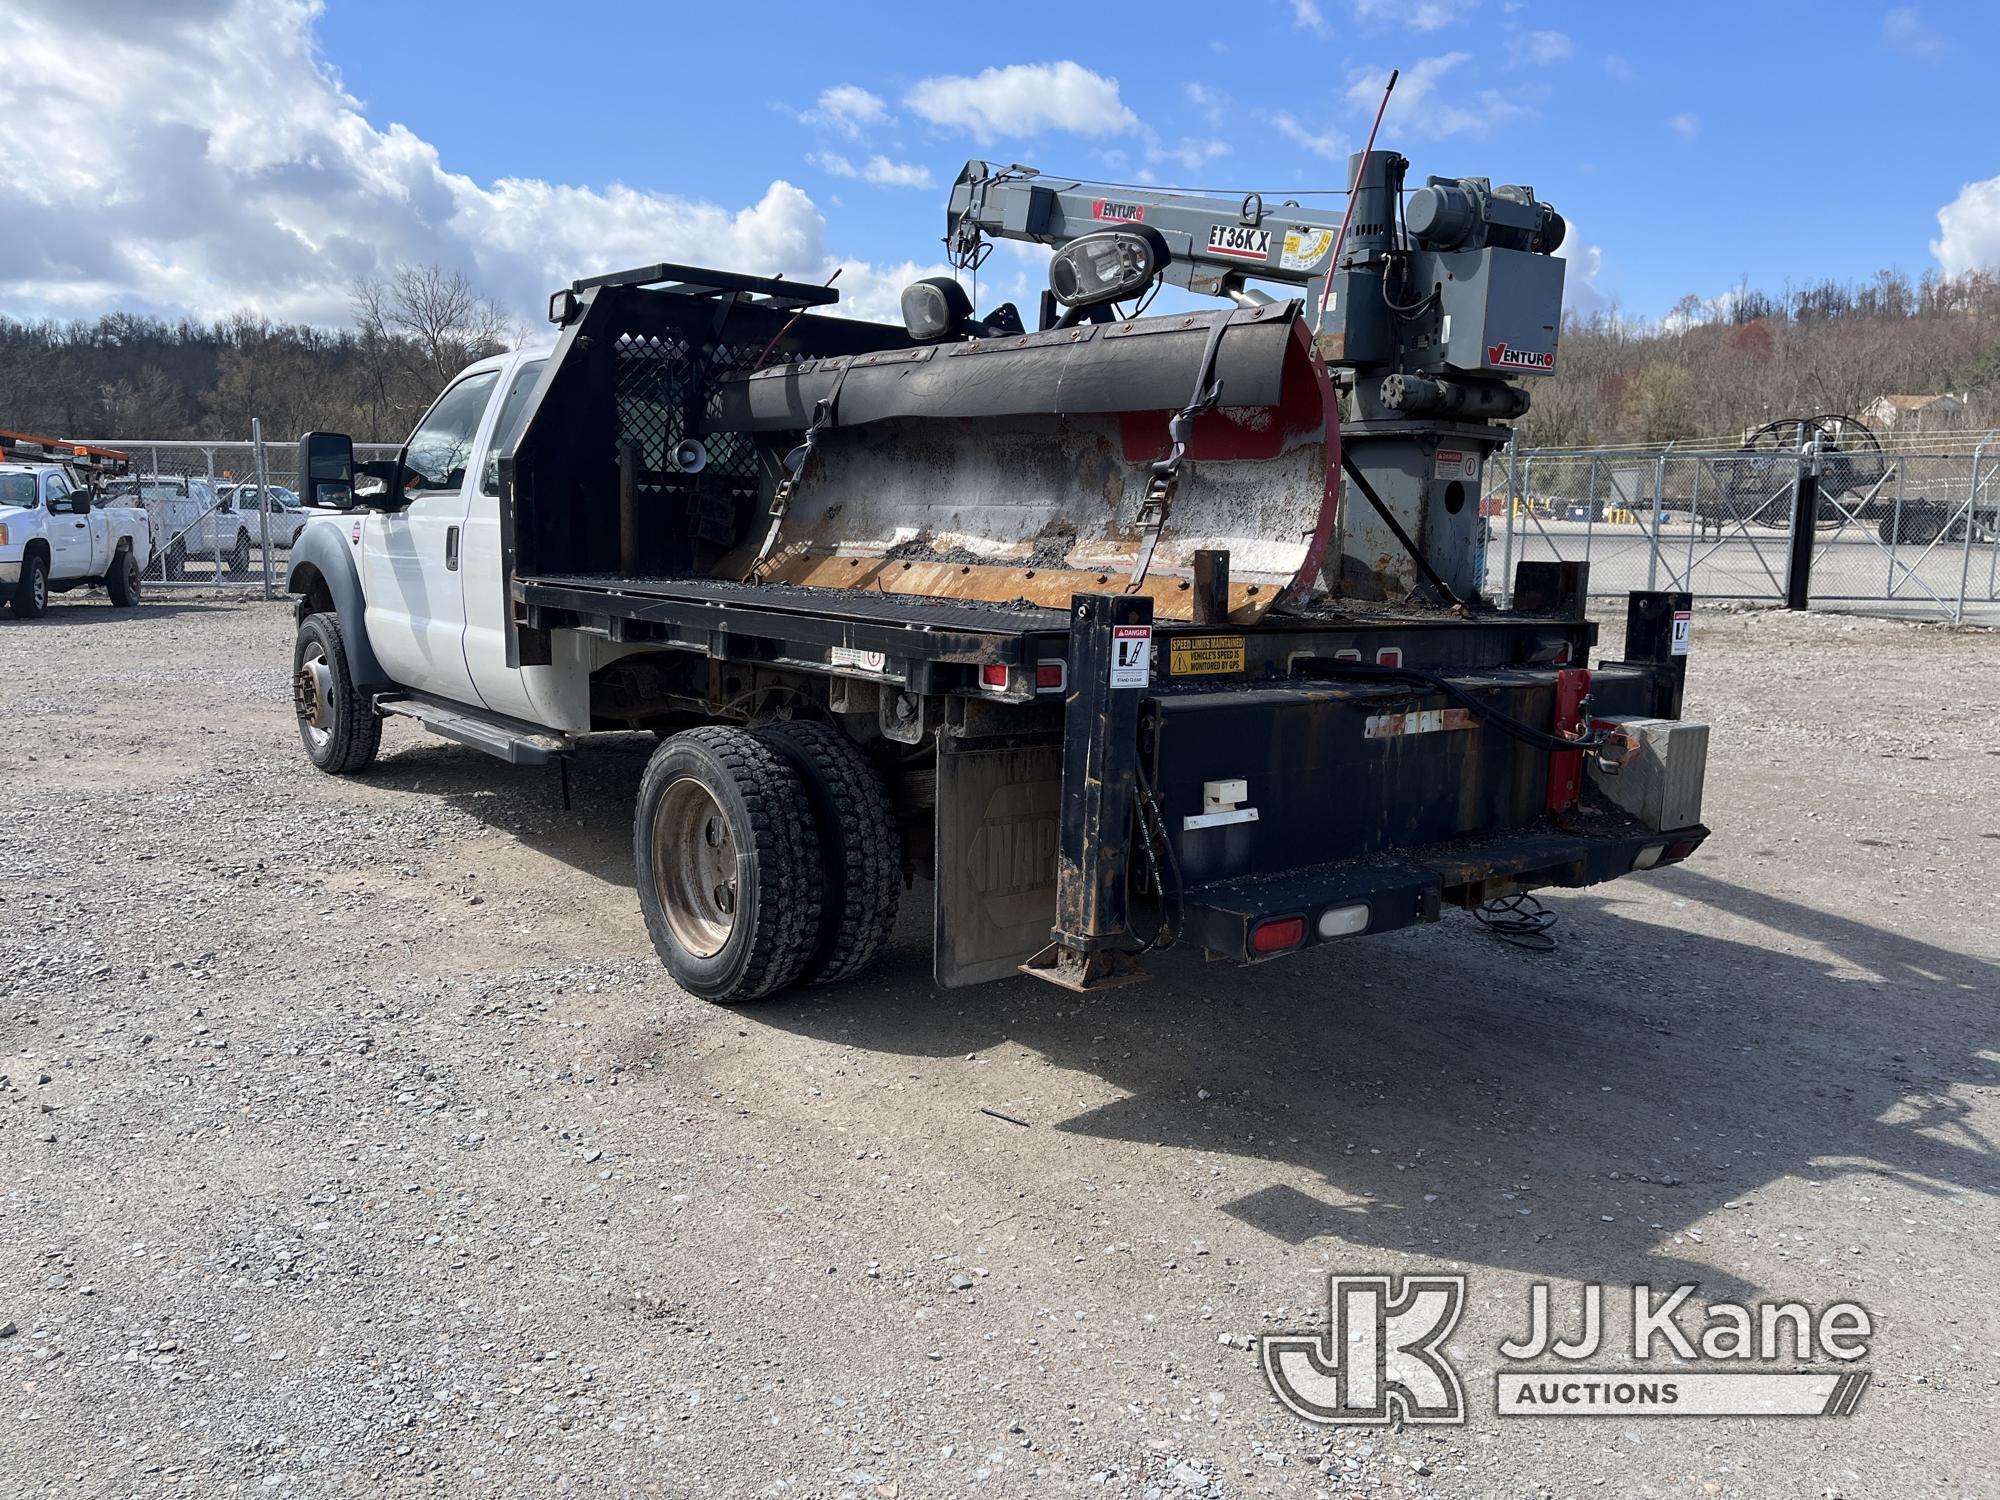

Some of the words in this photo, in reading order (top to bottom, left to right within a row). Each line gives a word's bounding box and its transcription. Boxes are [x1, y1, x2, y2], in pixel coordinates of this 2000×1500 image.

[1092, 199, 1144, 221] VENTURO
[1488, 343, 1553, 367] VENTURO
[1124, 629, 1147, 637] DANGER
[1172, 639, 1191, 650] SPEED
[1191, 638, 1211, 649] LIMITS
[1210, 637, 1244, 649] MAINTAINED
[1190, 651, 1217, 661] VEHICLE'S
[1217, 650, 1234, 660] SPEED
[1234, 649, 1240, 659] IS
[1190, 661, 1221, 672] MONITORED
[1221, 660, 1229, 670] BY
[1228, 659, 1240, 670] GPS
[985, 817, 1060, 892] NAP
